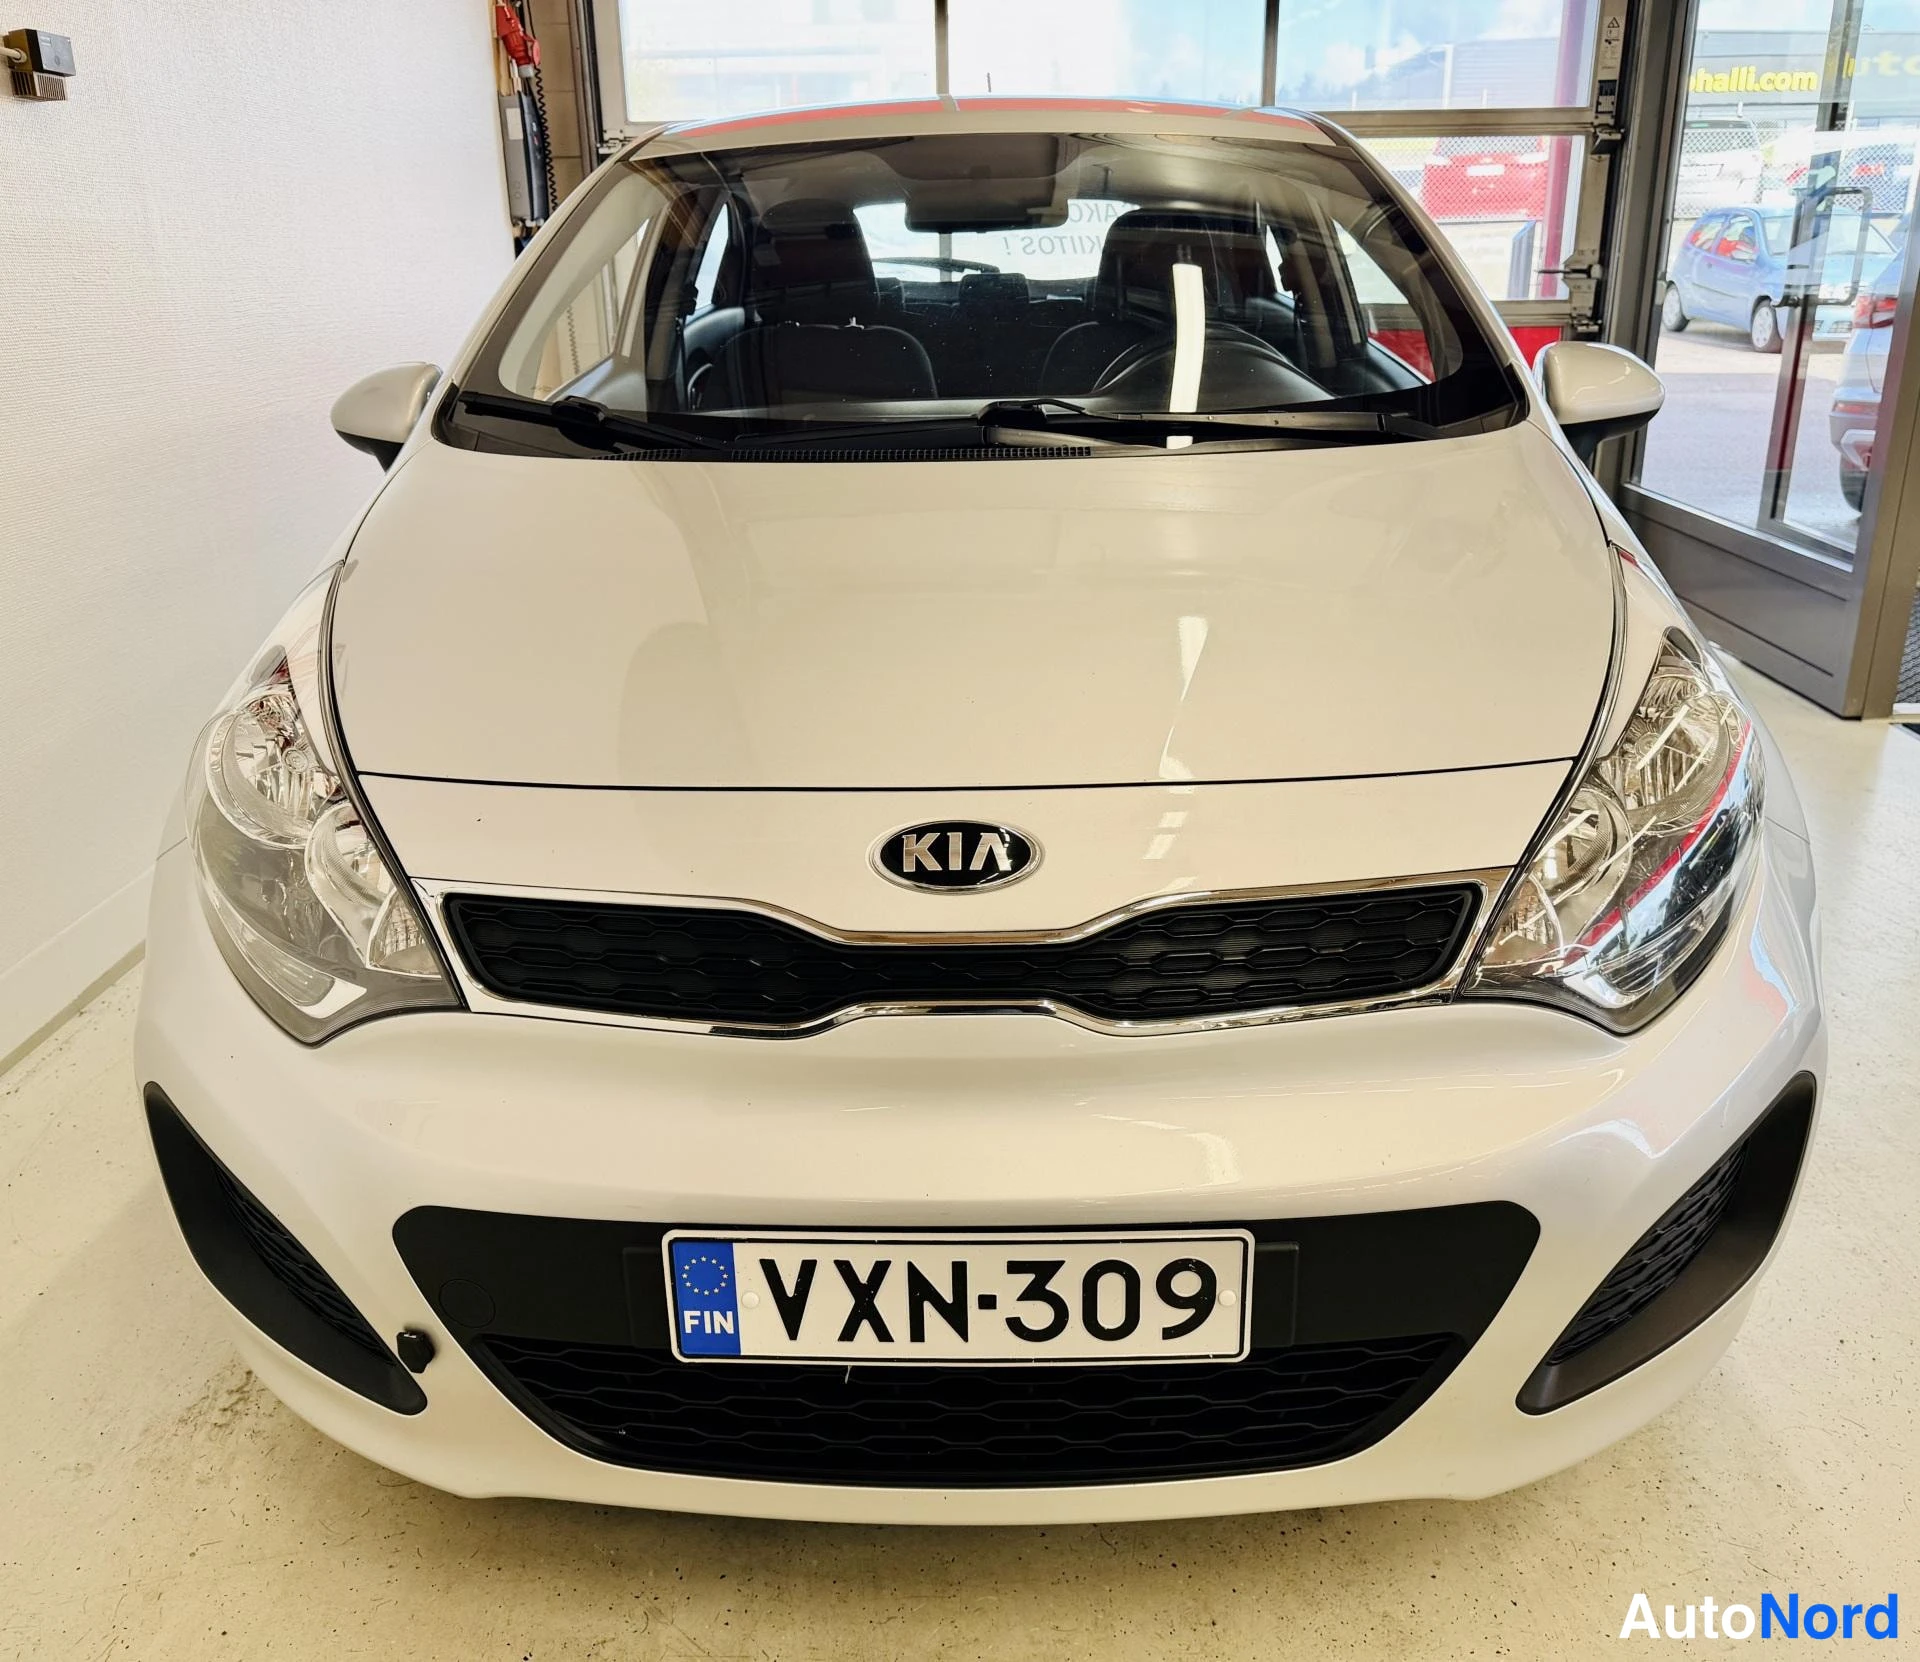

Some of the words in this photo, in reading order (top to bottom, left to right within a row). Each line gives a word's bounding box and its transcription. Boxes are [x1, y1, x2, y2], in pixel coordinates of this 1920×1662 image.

[901, 831, 1013, 873] KIA
[758, 1257, 1218, 1344] VXN-309
[683, 1309, 735, 1335] FIN
